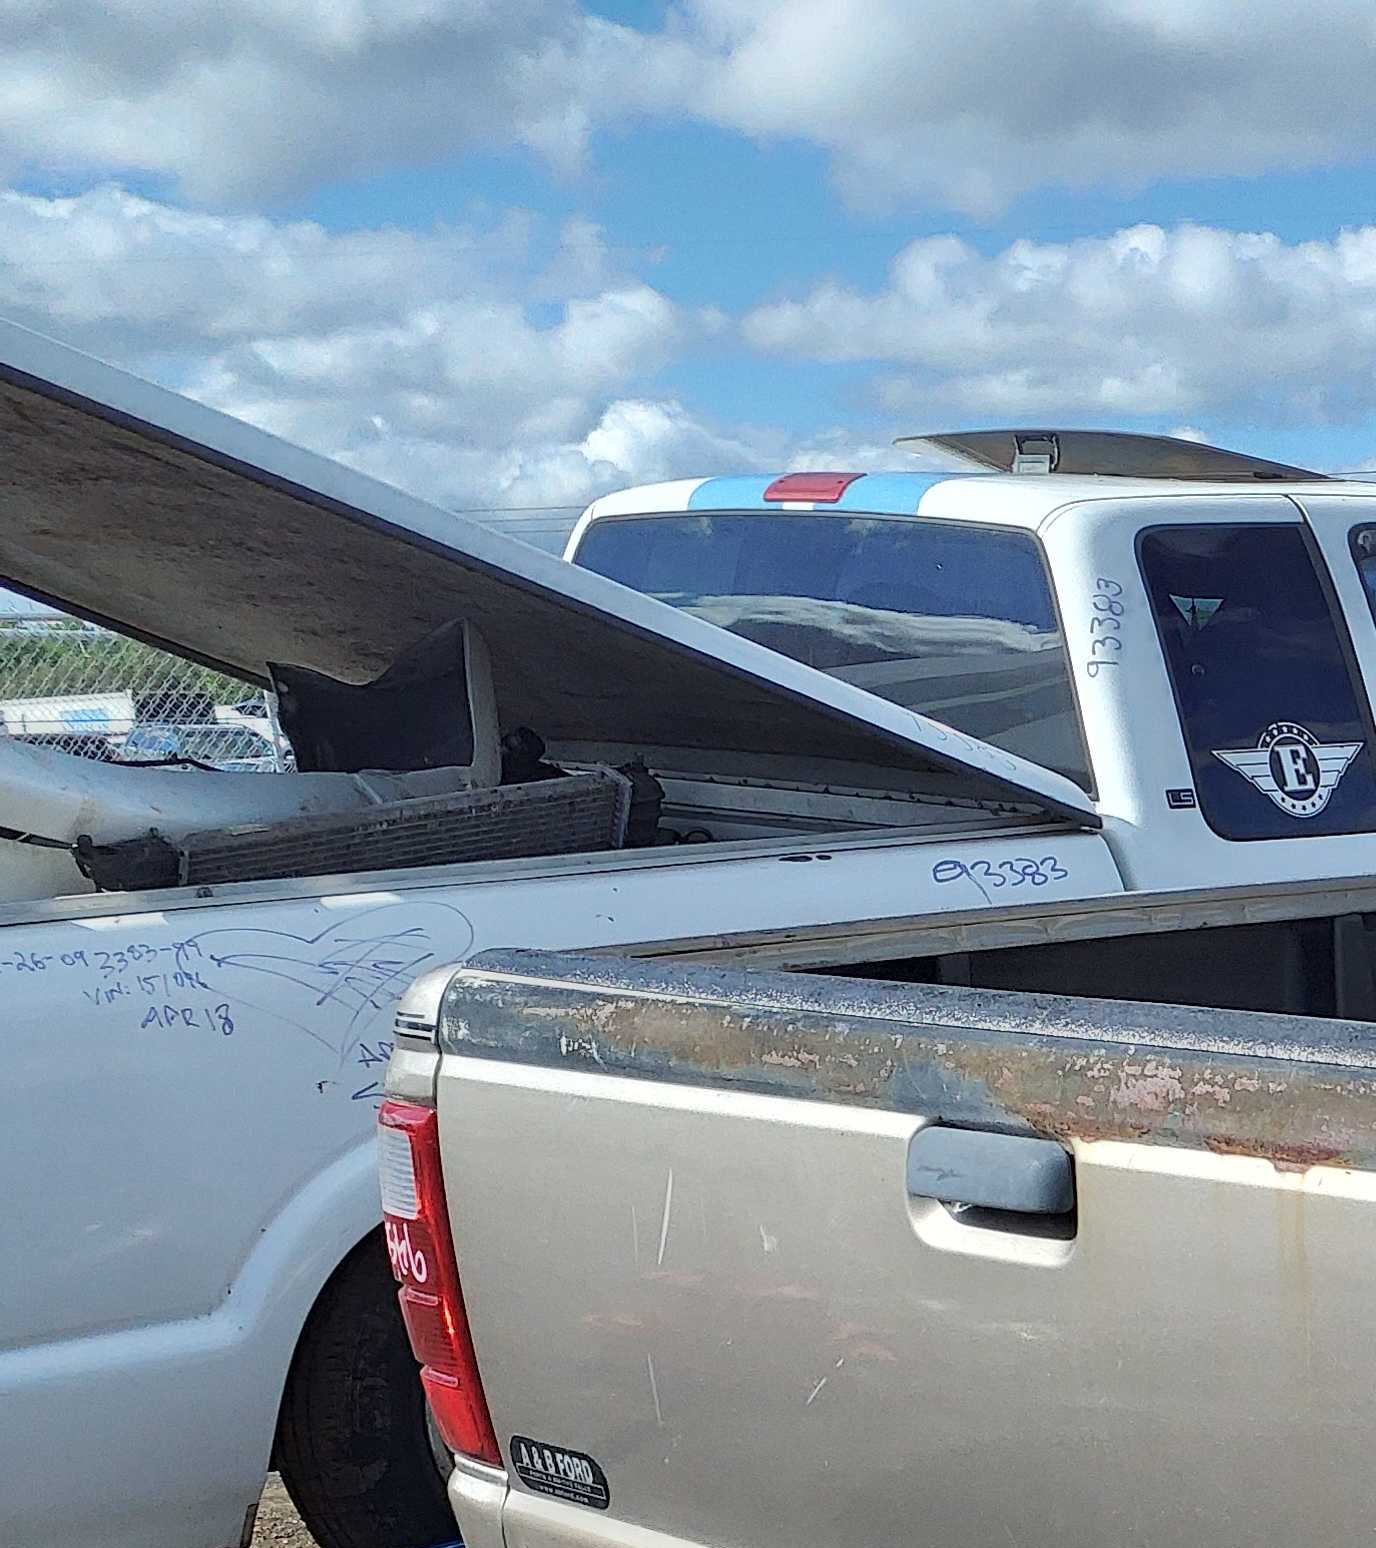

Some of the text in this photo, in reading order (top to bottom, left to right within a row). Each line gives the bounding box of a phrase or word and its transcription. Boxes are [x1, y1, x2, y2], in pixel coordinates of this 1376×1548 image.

[1087, 578, 1125, 678] 93383
[1273, 743, 1317, 793] E
[1168, 791, 1195, 806] LS
[140, 1004, 201, 1029] APR
[555, 1452, 594, 1484] FORD
